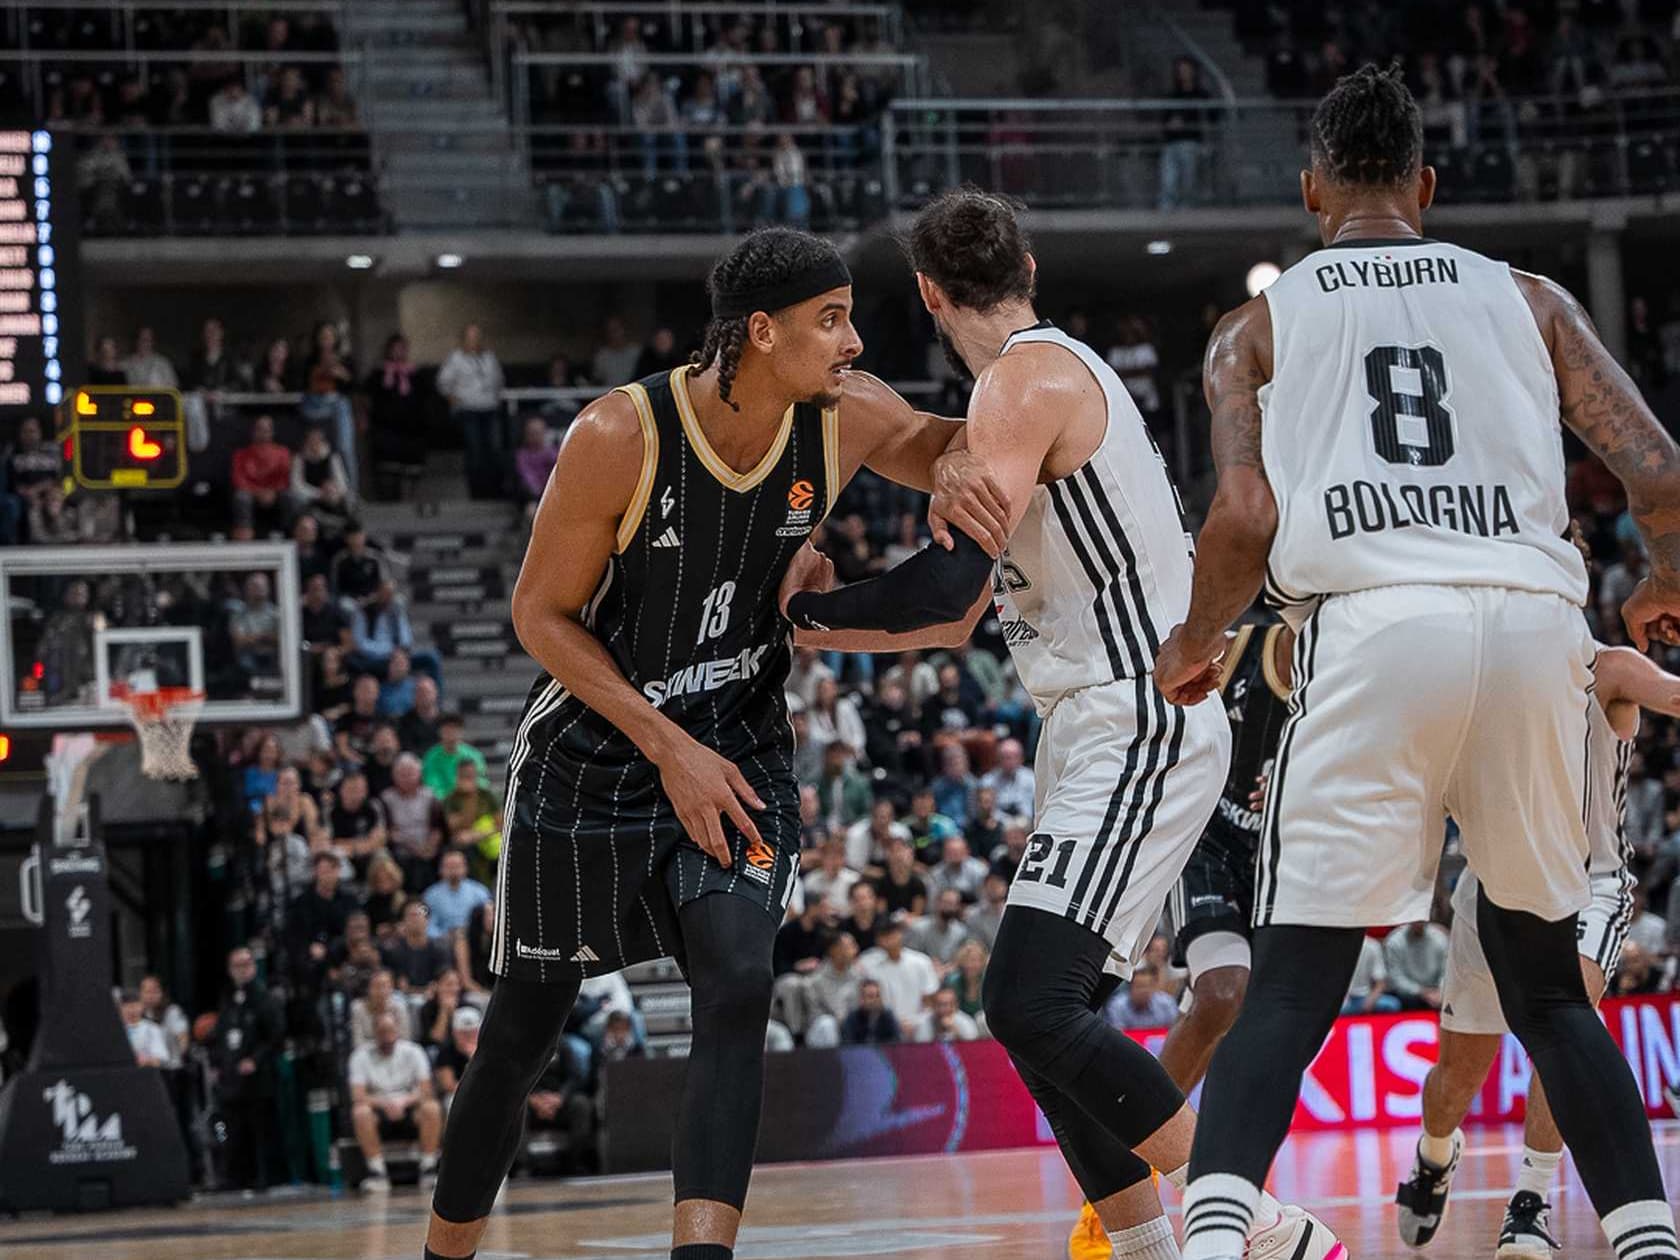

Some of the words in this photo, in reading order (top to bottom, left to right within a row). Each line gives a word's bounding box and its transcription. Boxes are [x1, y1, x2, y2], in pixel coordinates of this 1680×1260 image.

[1316, 257, 1459, 293] CLYBURN
[1363, 345, 1456, 467] 8
[1325, 480, 1521, 541] BOLOGNA
[697, 580, 736, 645] 13
[1016, 833, 1078, 889] 21
